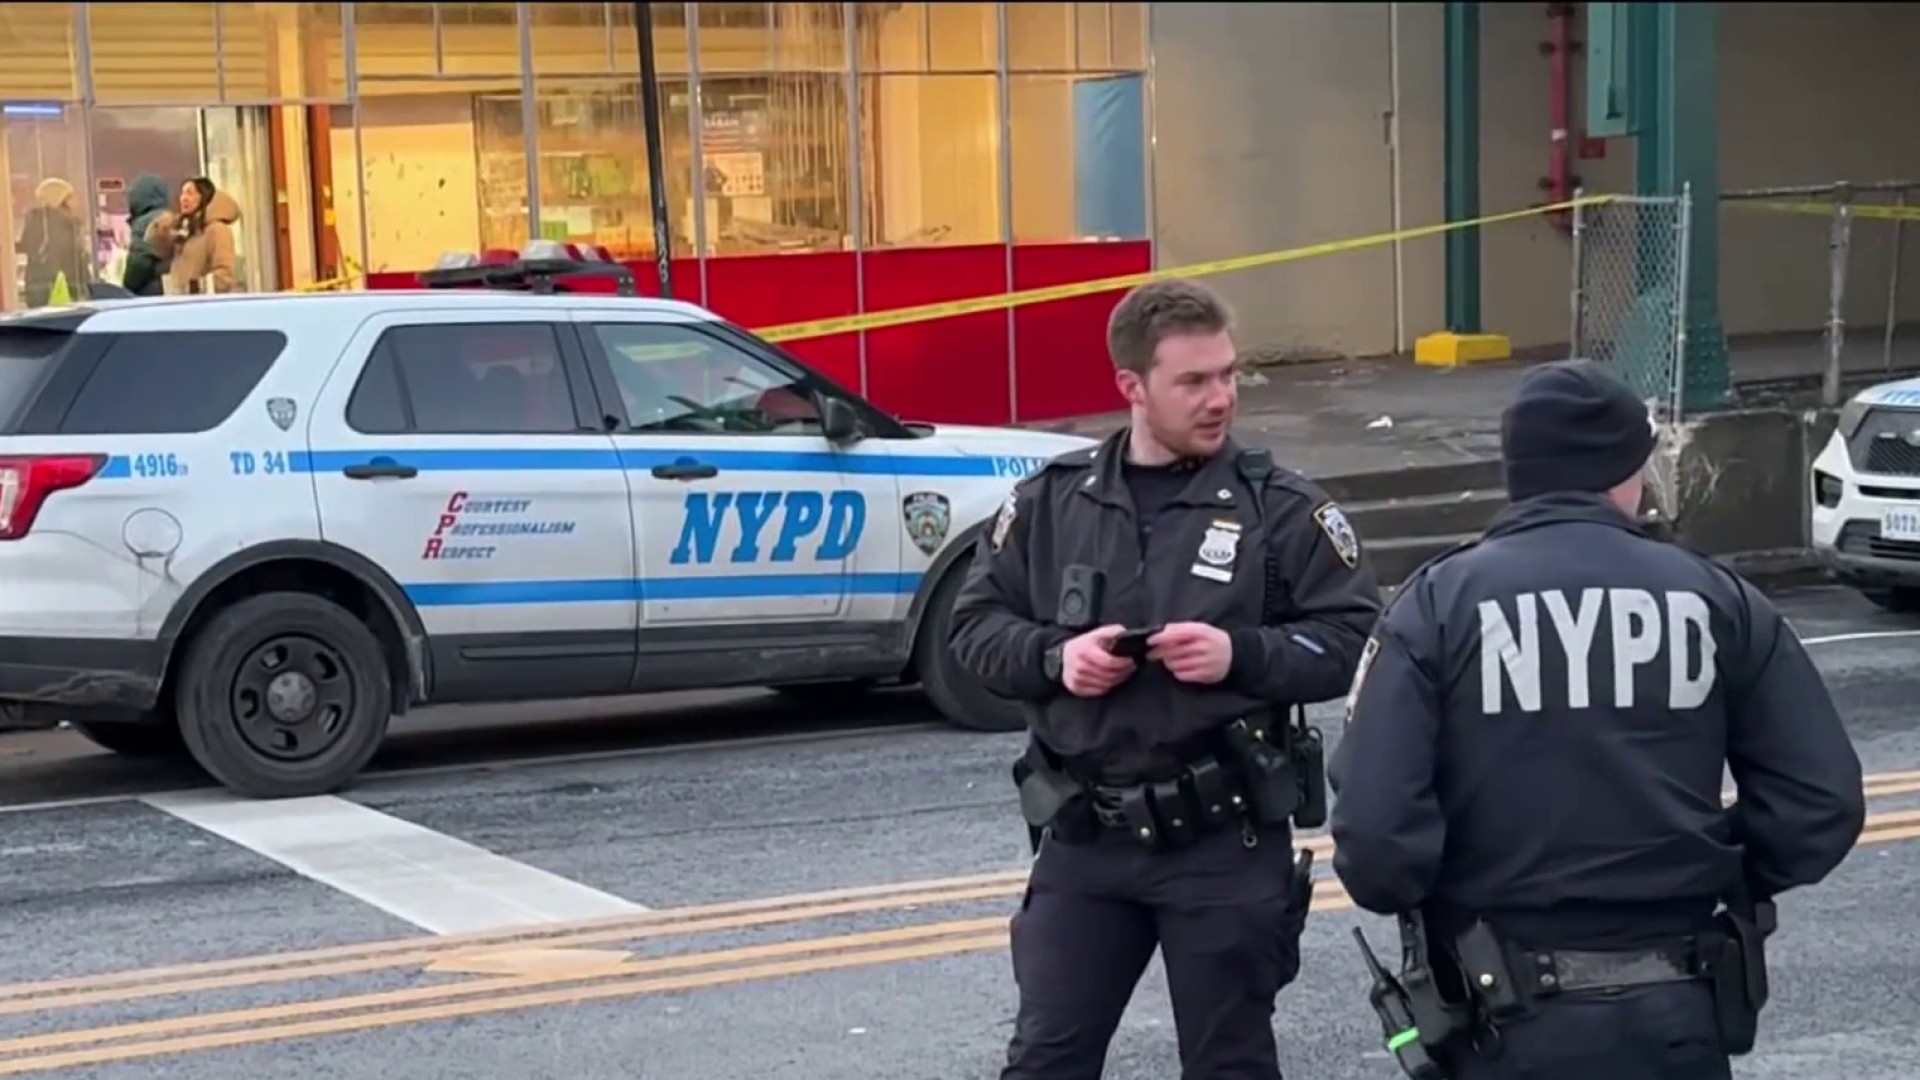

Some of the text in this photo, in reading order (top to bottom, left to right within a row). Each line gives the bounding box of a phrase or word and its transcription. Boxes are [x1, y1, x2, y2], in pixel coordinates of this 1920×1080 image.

[134, 453, 178, 477] 4916
[230, 450, 285, 475] TD 34
[669, 490, 867, 564] NYPD
[1478, 587, 1717, 713] NYPD
